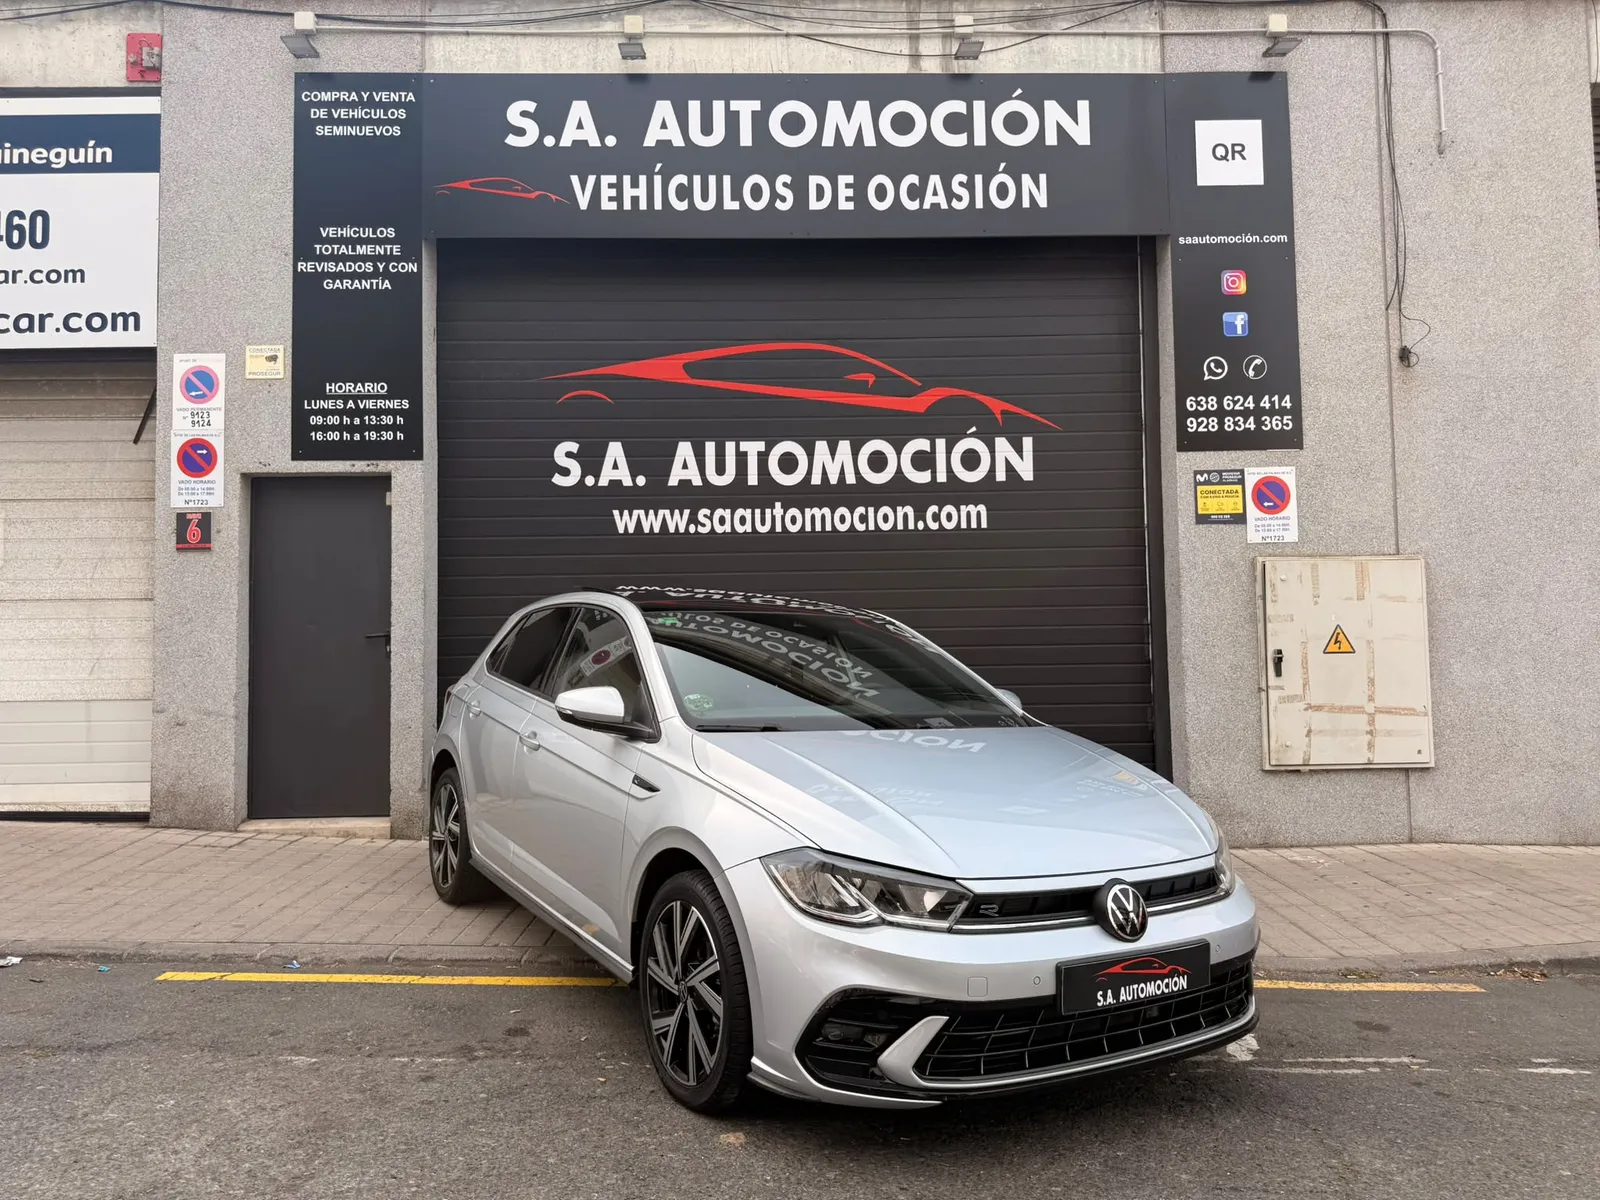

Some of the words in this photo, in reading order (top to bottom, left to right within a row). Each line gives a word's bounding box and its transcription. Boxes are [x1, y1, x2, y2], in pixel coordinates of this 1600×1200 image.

[301, 92, 359, 103] COMPRA
[360, 92, 370, 103] Y
[372, 92, 416, 103] VENTA
[310, 108, 328, 119] DE
[331, 105, 407, 120] VEHÍCULOS
[505, 100, 616, 148] S.A.
[643, 88, 1091, 148] AUTOMOCIÓN
[315, 125, 401, 137] SEMINUEVOS
[1211, 143, 1247, 163] QR
[570, 163, 793, 212] VEHÍCULOS
[808, 174, 855, 211] DE
[867, 163, 1048, 211] OCASIÓN
[319, 224, 396, 238] VEHÍCULOS
[1178, 233, 1288, 245] saautomoción.com
[313, 244, 402, 256] TOTALMENTE
[297, 262, 373, 273] REVISADOS
[377, 262, 386, 273] Y
[389, 262, 418, 273] CON
[323, 276, 392, 290] GARANTÍA
[325, 383, 388, 396] HORARIO
[304, 399, 344, 410] LUNES
[346, 399, 356, 410] A
[358, 399, 410, 410] VIERNES
[1185, 396, 1218, 412] 638
[1223, 395, 1256, 411] 624
[1259, 395, 1293, 410] 414
[190, 411, 211, 420] 9123
[309, 415, 340, 426] 09:00
[343, 415, 351, 426] h
[353, 417, 361, 426] a
[363, 414, 394, 426] 13:30
[396, 415, 404, 426] h
[190, 419, 212, 428] 9124
[1186, 416, 1219, 433] 928
[1224, 415, 1256, 432] 834
[1261, 415, 1293, 431] 365
[309, 430, 341, 442] 16:00
[343, 430, 351, 441] h
[353, 432, 361, 441] a
[363, 430, 394, 441] 19:30
[396, 430, 404, 441] h
[552, 441, 647, 487] S.A.
[668, 426, 1034, 487] AUTOMOCIÓN
[612, 502, 988, 534] www.saautomocion.com
[186, 518, 202, 544] 6
[1096, 988, 1117, 1007] S.A.
[1120, 973, 1188, 1003] AUTOMOCIÓN
